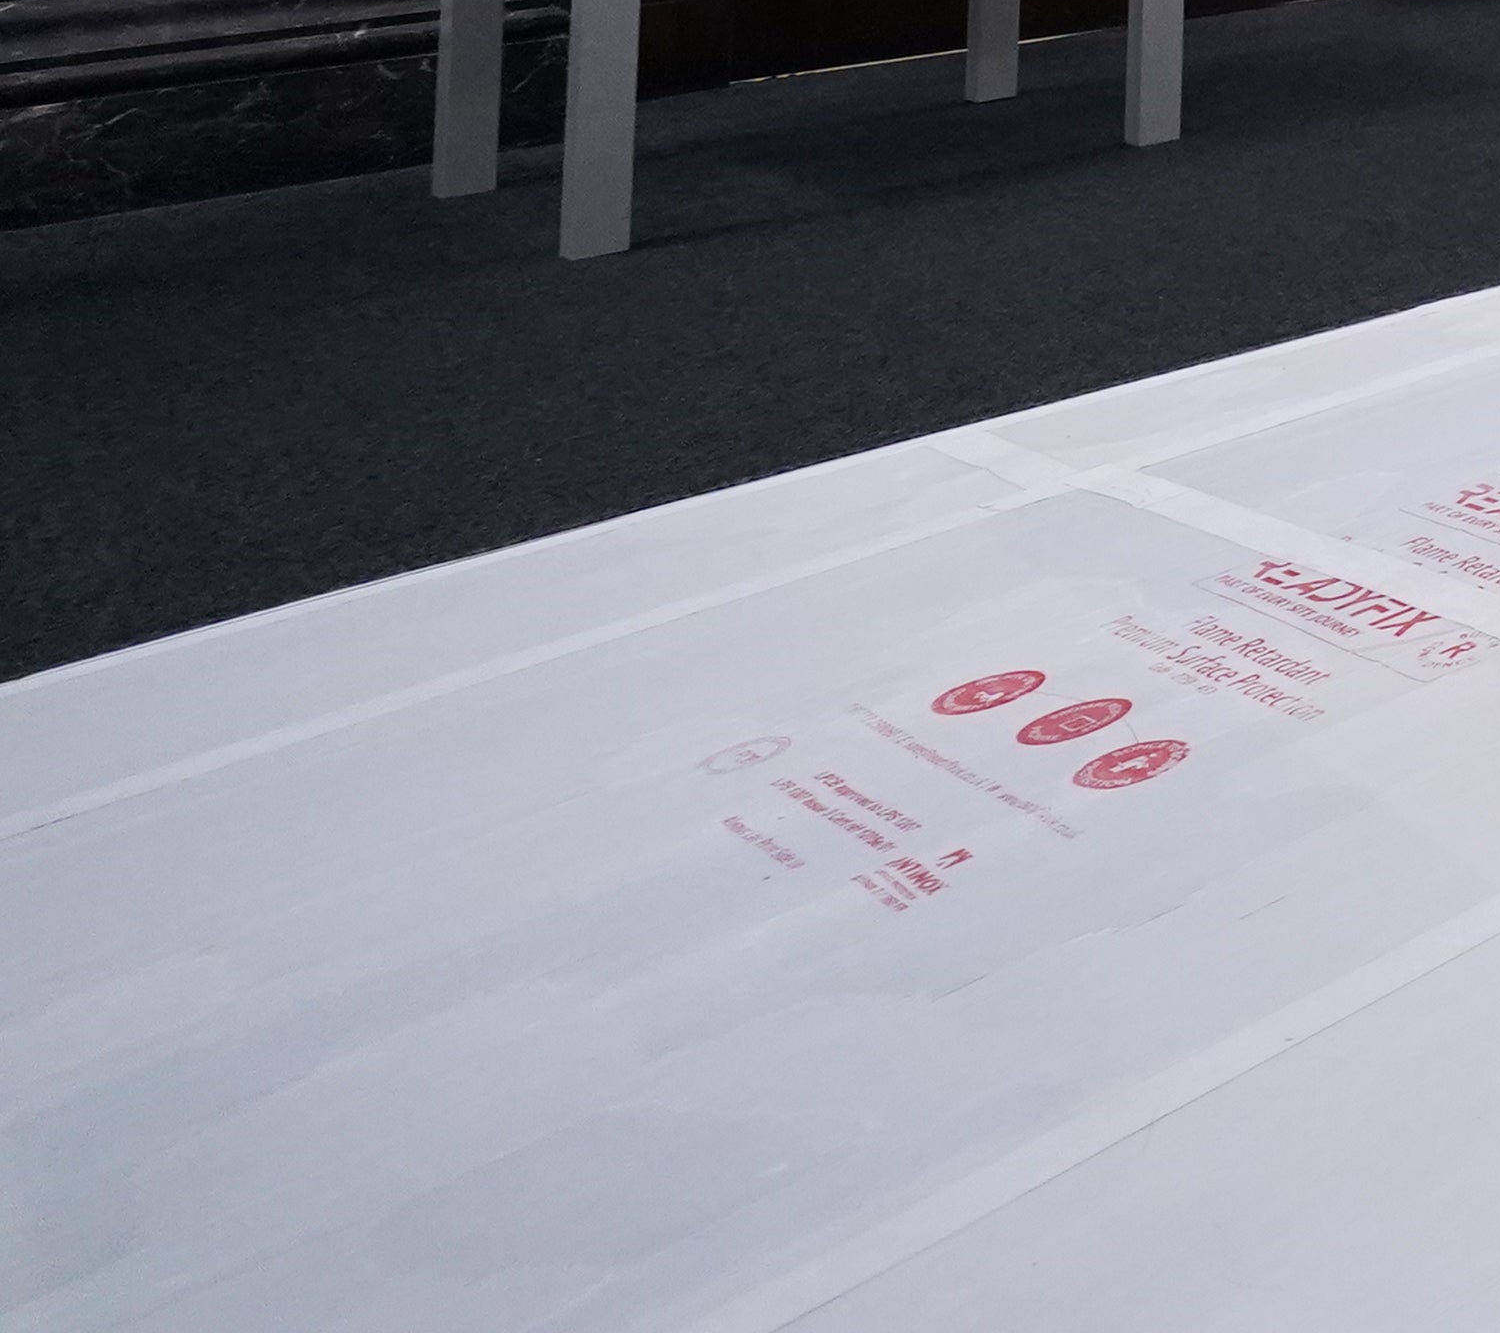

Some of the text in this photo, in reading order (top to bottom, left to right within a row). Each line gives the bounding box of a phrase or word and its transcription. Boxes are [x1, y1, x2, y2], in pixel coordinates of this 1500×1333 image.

[1401, 536, 1457, 564] Flame
[1252, 561, 1441, 638] READYFIX
[1165, 645, 1236, 685] Surface
[1227, 673, 1325, 722] Protection
[1186, 615, 1242, 649] Flame
[1232, 638, 1330, 687] Retardant
